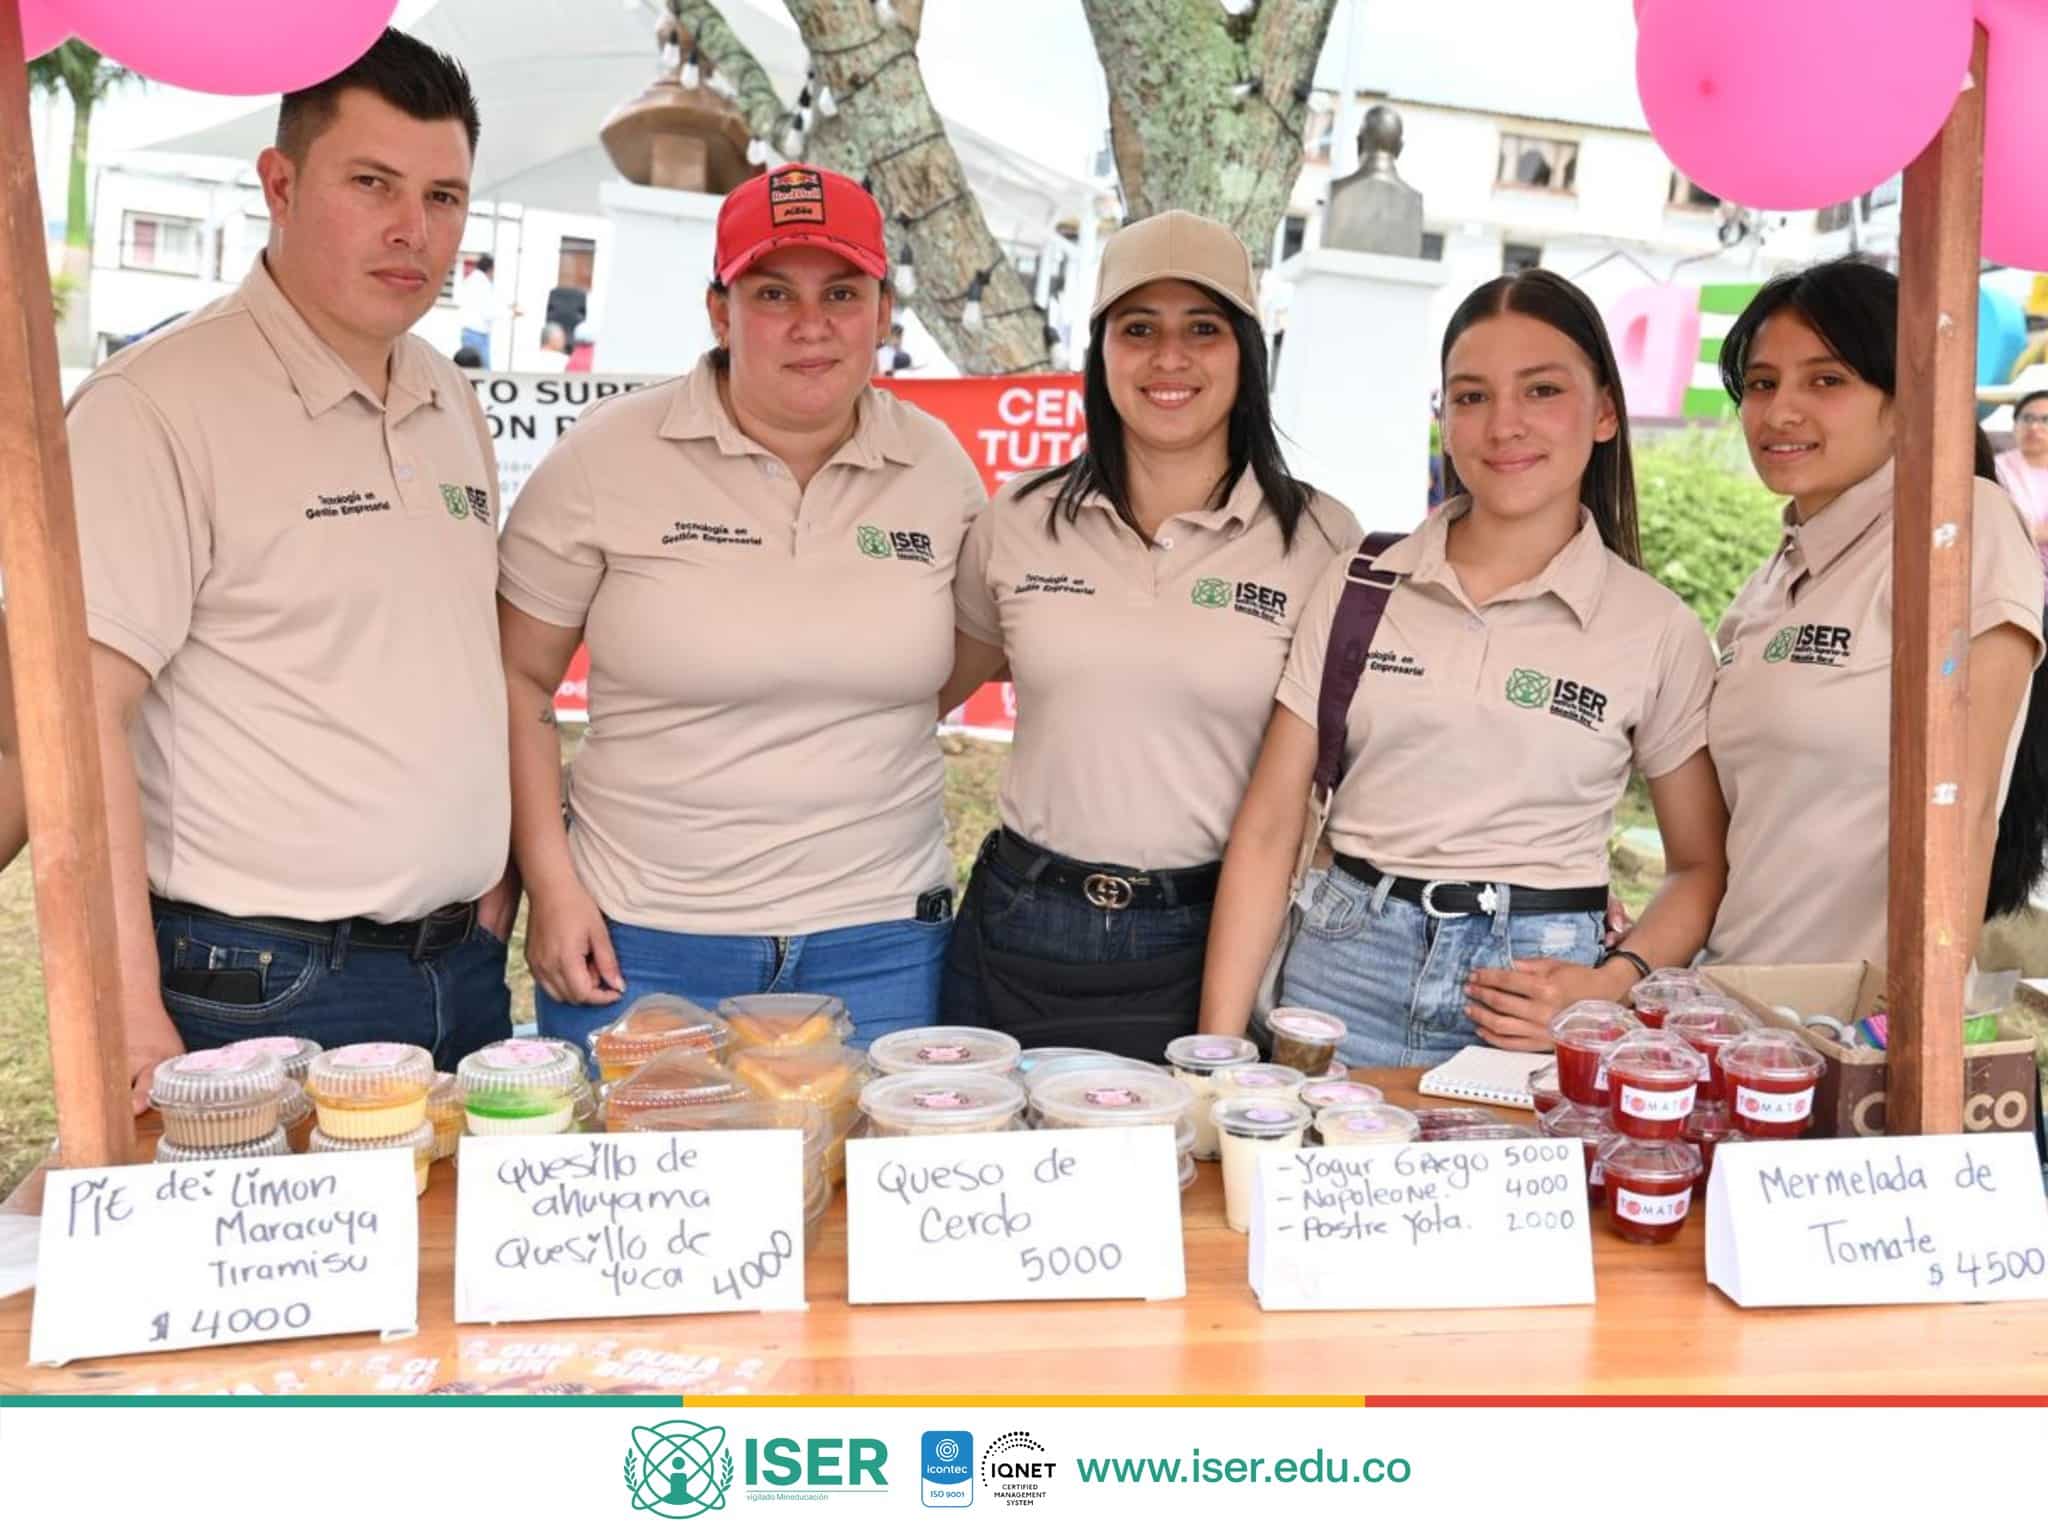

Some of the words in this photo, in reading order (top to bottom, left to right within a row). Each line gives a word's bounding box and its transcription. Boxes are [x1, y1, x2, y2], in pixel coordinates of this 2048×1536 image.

[889, 531, 931, 551] ISER
[1235, 581, 1288, 611] ISER
[1796, 623, 1852, 650] ISER
[1553, 678, 1608, 715] ISER
[657, 1137, 698, 1173] de
[1504, 1144, 1570, 1167] 5000
[877, 1160, 1005, 1205] Queso
[1034, 1147, 1077, 1184] de
[1505, 1174, 1569, 1198] 4000
[1758, 1155, 1929, 1204] Mermelada
[1955, 1151, 1998, 1192] de
[531, 1183, 711, 1225] ahuyama
[919, 1191, 1032, 1243] Cerdo
[1508, 1209, 1575, 1232] 2000
[215, 1209, 379, 1247] Maracuya
[1807, 1216, 1937, 1265] Tomate
[496, 1225, 647, 1270] Quesillo
[712, 1229, 793, 1300] 4000
[1020, 1242, 1122, 1282] 5000
[1957, 1247, 2047, 1288] 4500
[191, 1302, 312, 1339] 4000
